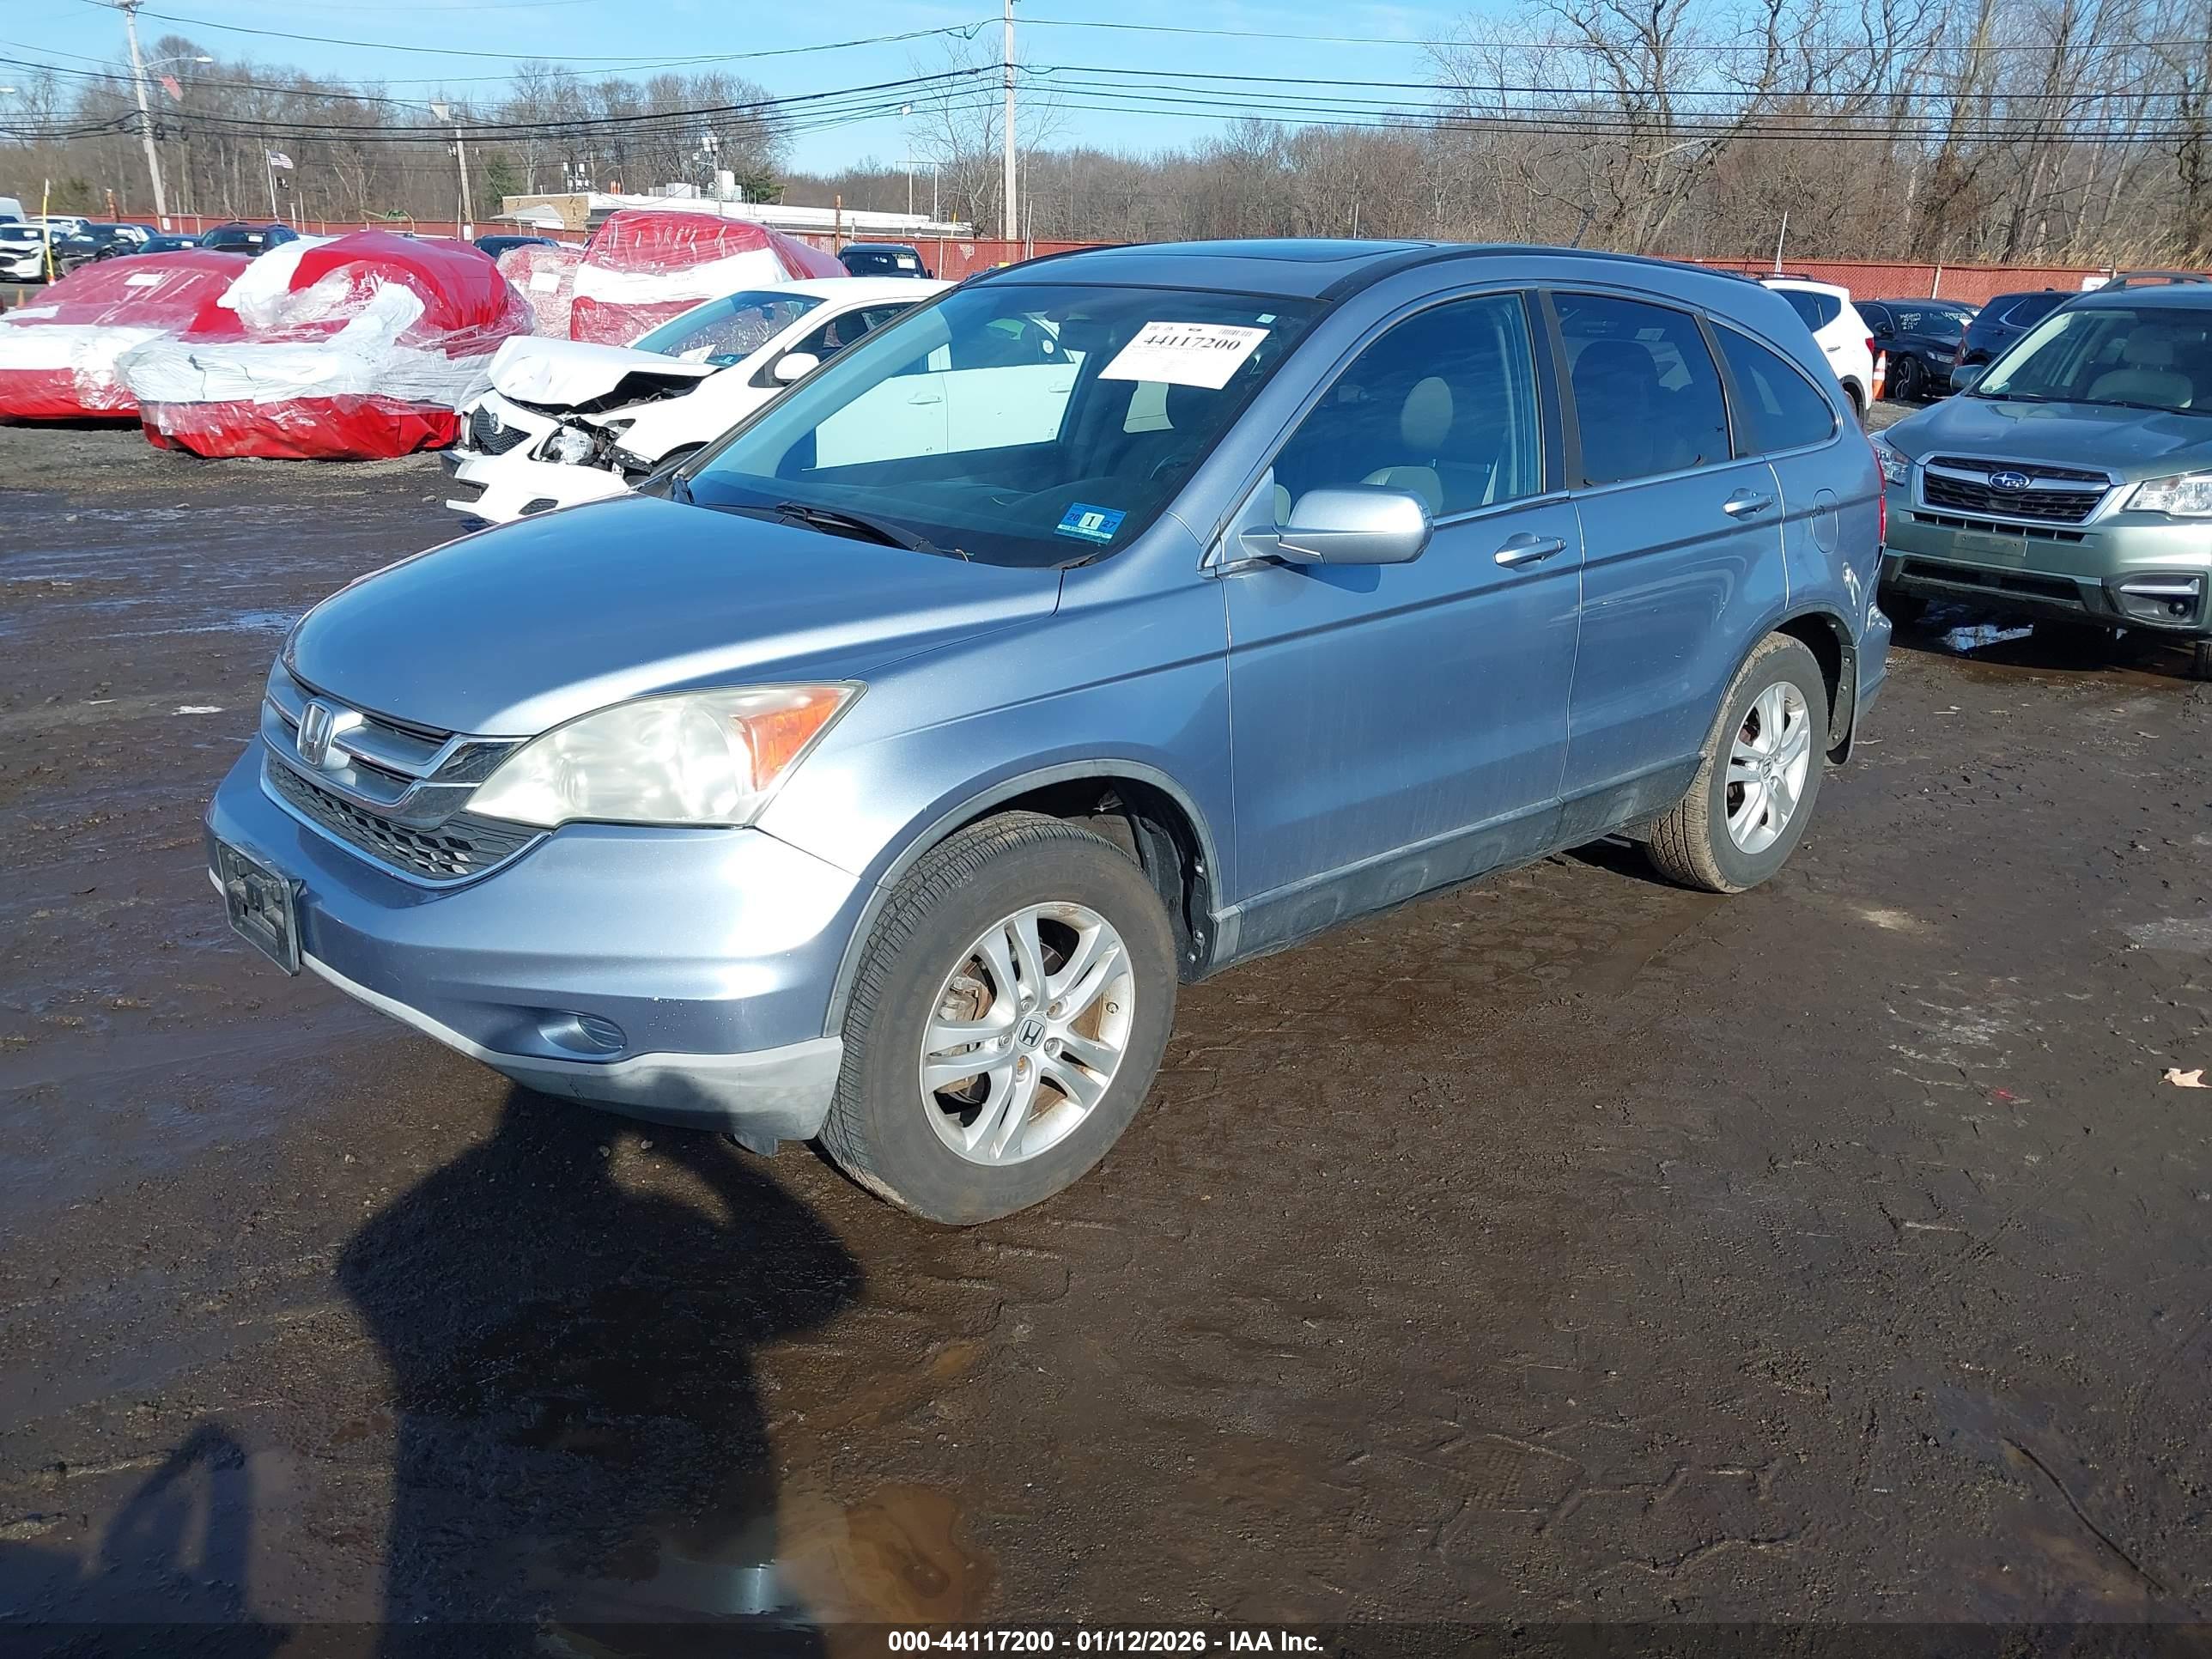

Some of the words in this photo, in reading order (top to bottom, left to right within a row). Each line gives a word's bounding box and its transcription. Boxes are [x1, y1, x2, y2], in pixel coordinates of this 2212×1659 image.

[1143, 334, 1242, 351] 44117200
[1067, 513, 1081, 522] 20
[1085, 515, 1097, 527] 1
[1102, 520, 1117, 529] 27
